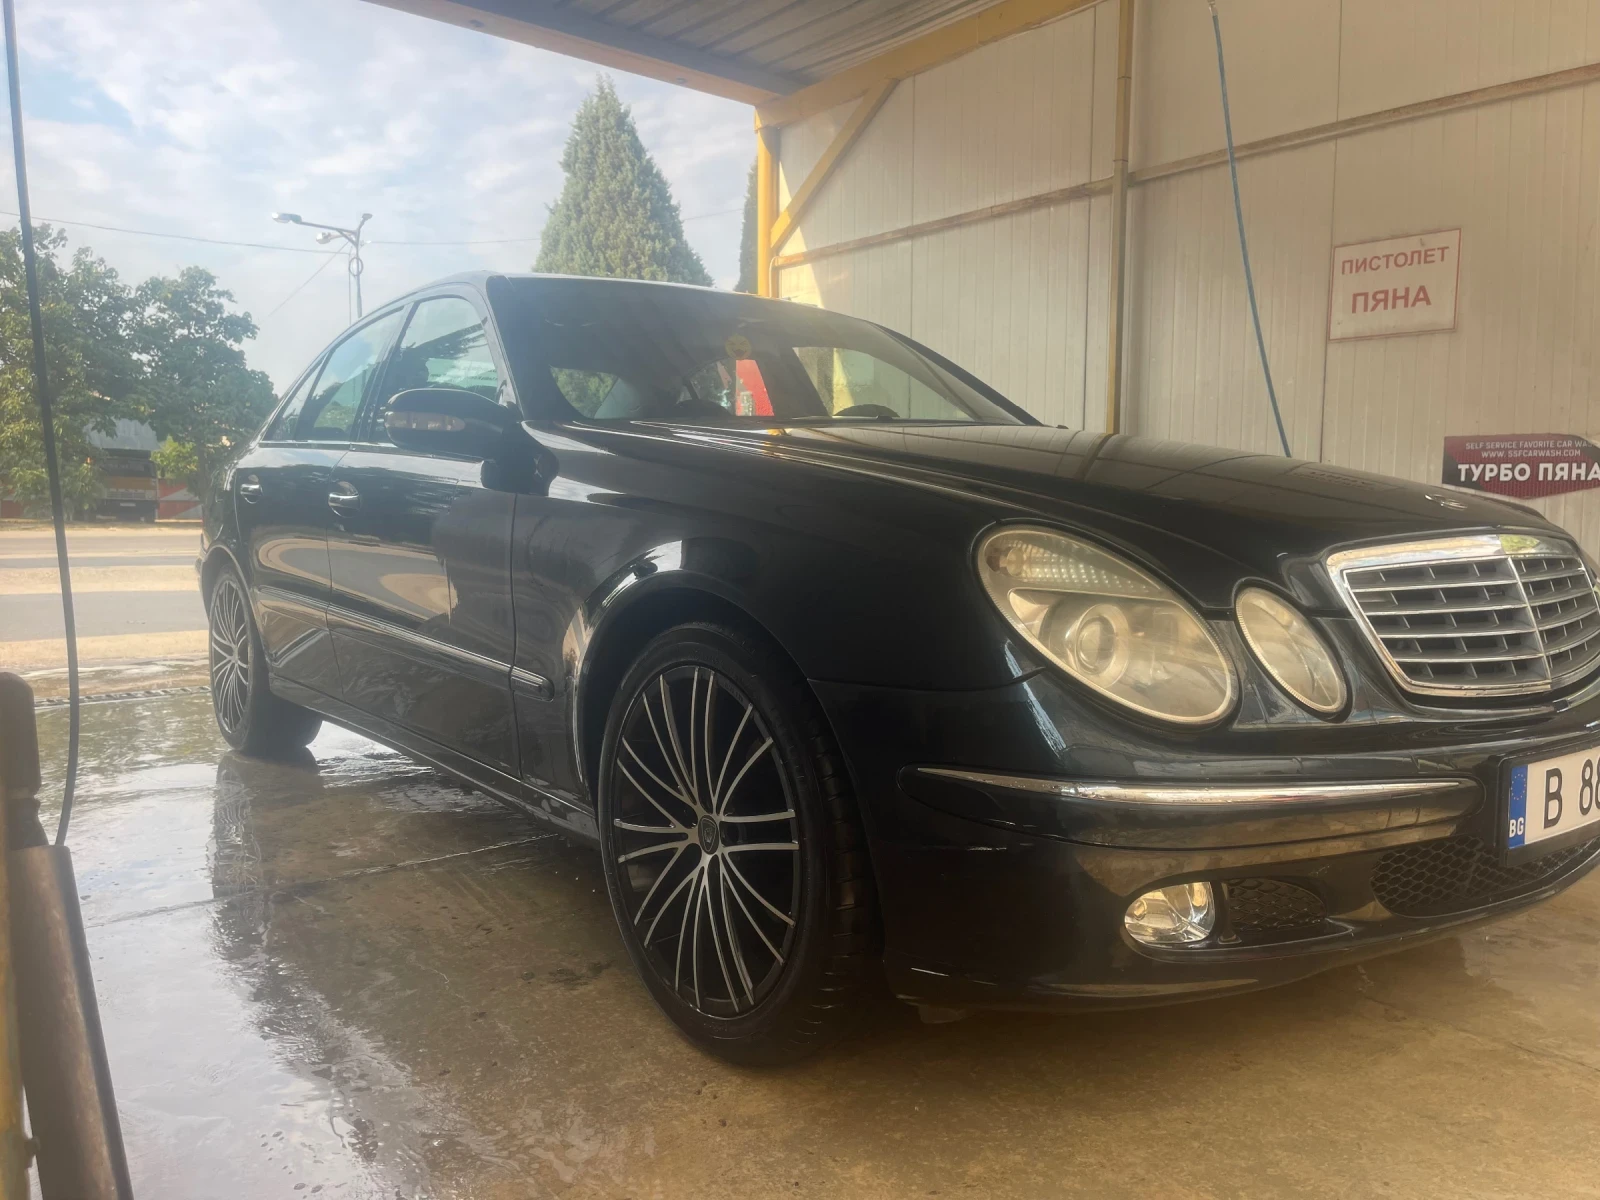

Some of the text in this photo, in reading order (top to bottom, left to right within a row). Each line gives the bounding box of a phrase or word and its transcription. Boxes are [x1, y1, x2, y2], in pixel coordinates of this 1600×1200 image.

[1341, 246, 1450, 276] ПИСТОЛЕТ
[1351, 285, 1432, 314] ПЯНА
[1520, 440, 1555, 449] FAVORITE
[1557, 440, 1573, 448] CAR
[1457, 462, 1600, 482] ТУРБО ПЯНА
[1544, 767, 1563, 829] B
[1509, 817, 1524, 838] BG
